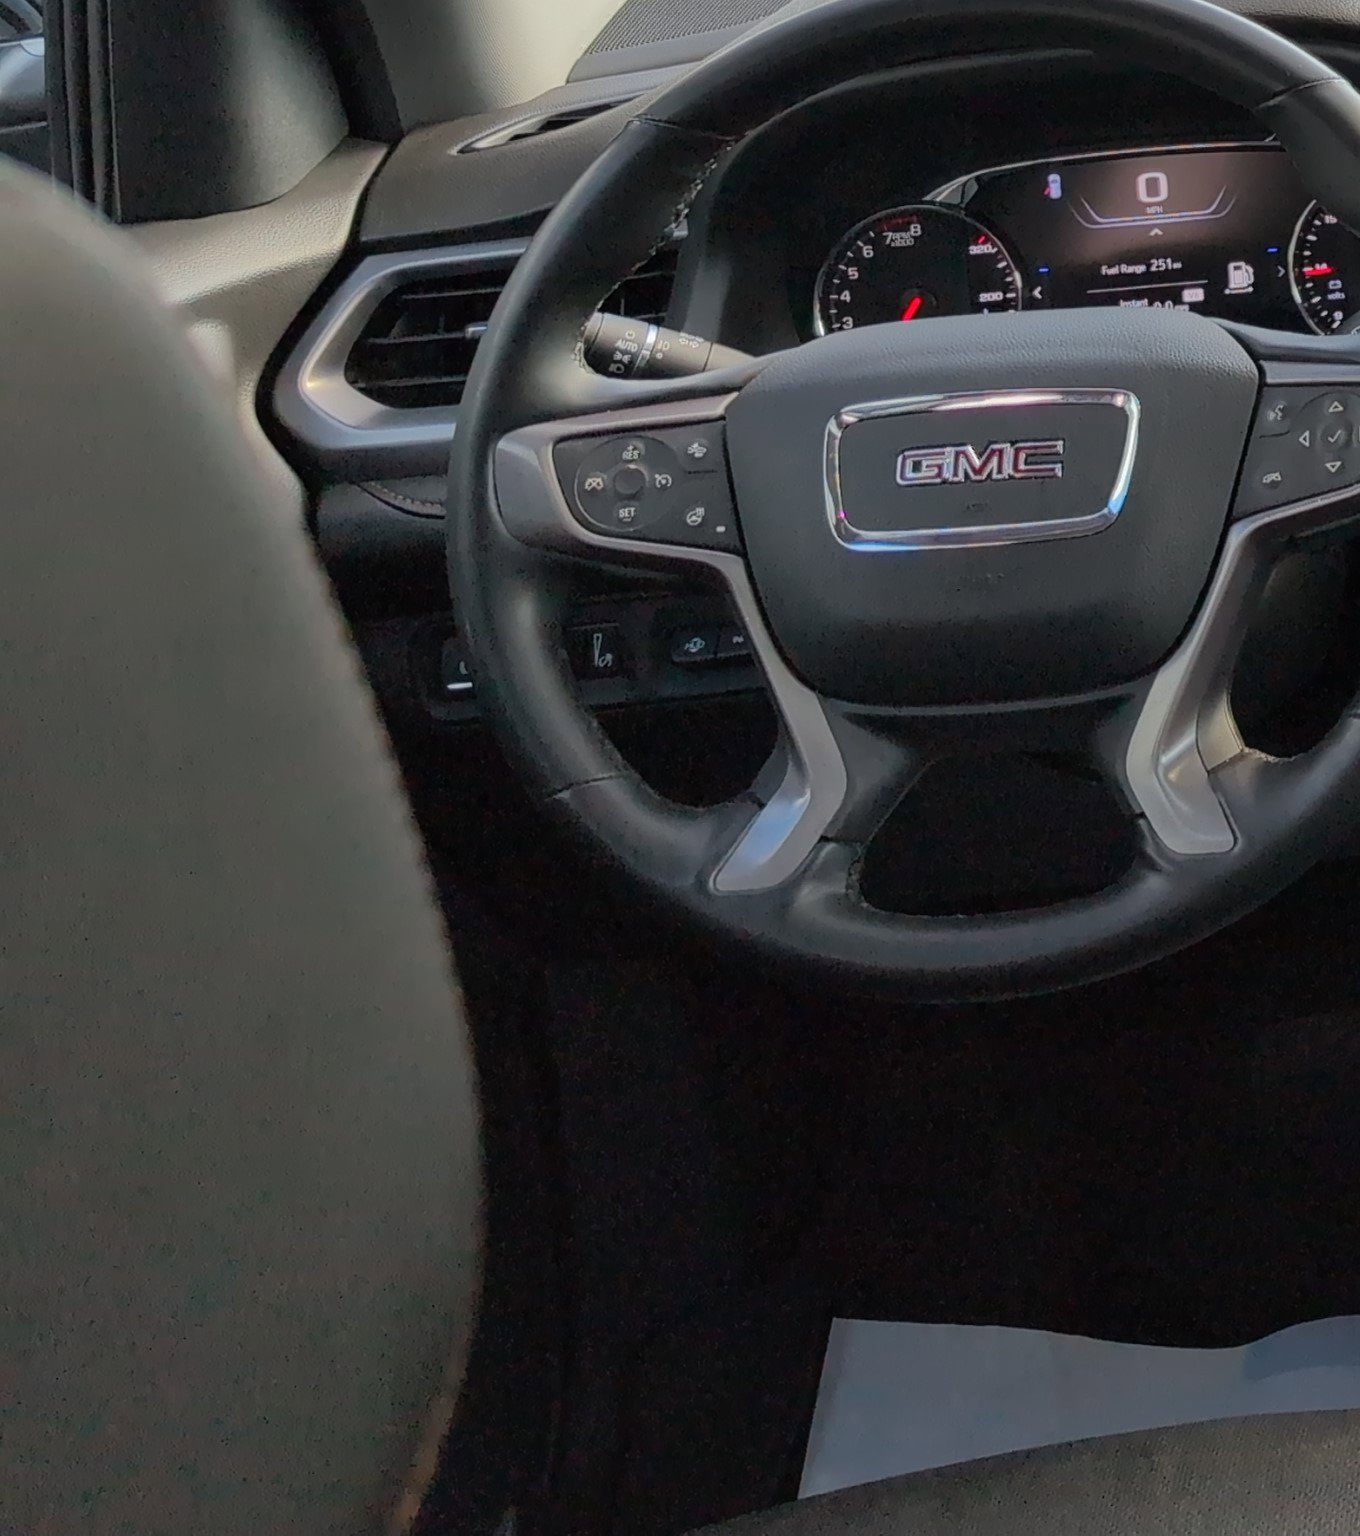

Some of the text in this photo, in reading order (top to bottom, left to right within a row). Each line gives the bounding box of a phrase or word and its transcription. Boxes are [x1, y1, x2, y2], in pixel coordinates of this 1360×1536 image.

[1136, 171, 1169, 203] 0
[909, 223, 922, 236] 8
[882, 231, 893, 245] 7
[862, 245, 874, 258] 6
[847, 267, 859, 280] 5
[1101, 264, 1119, 276] Fuel
[1120, 263, 1148, 275] Range
[840, 290, 851, 303] 4
[841, 316, 854, 330] 3
[615, 338, 638, 352] AUTO
[622, 449, 640, 461] RES
[893, 438, 1065, 487] GMC
[618, 506, 637, 518] SET
